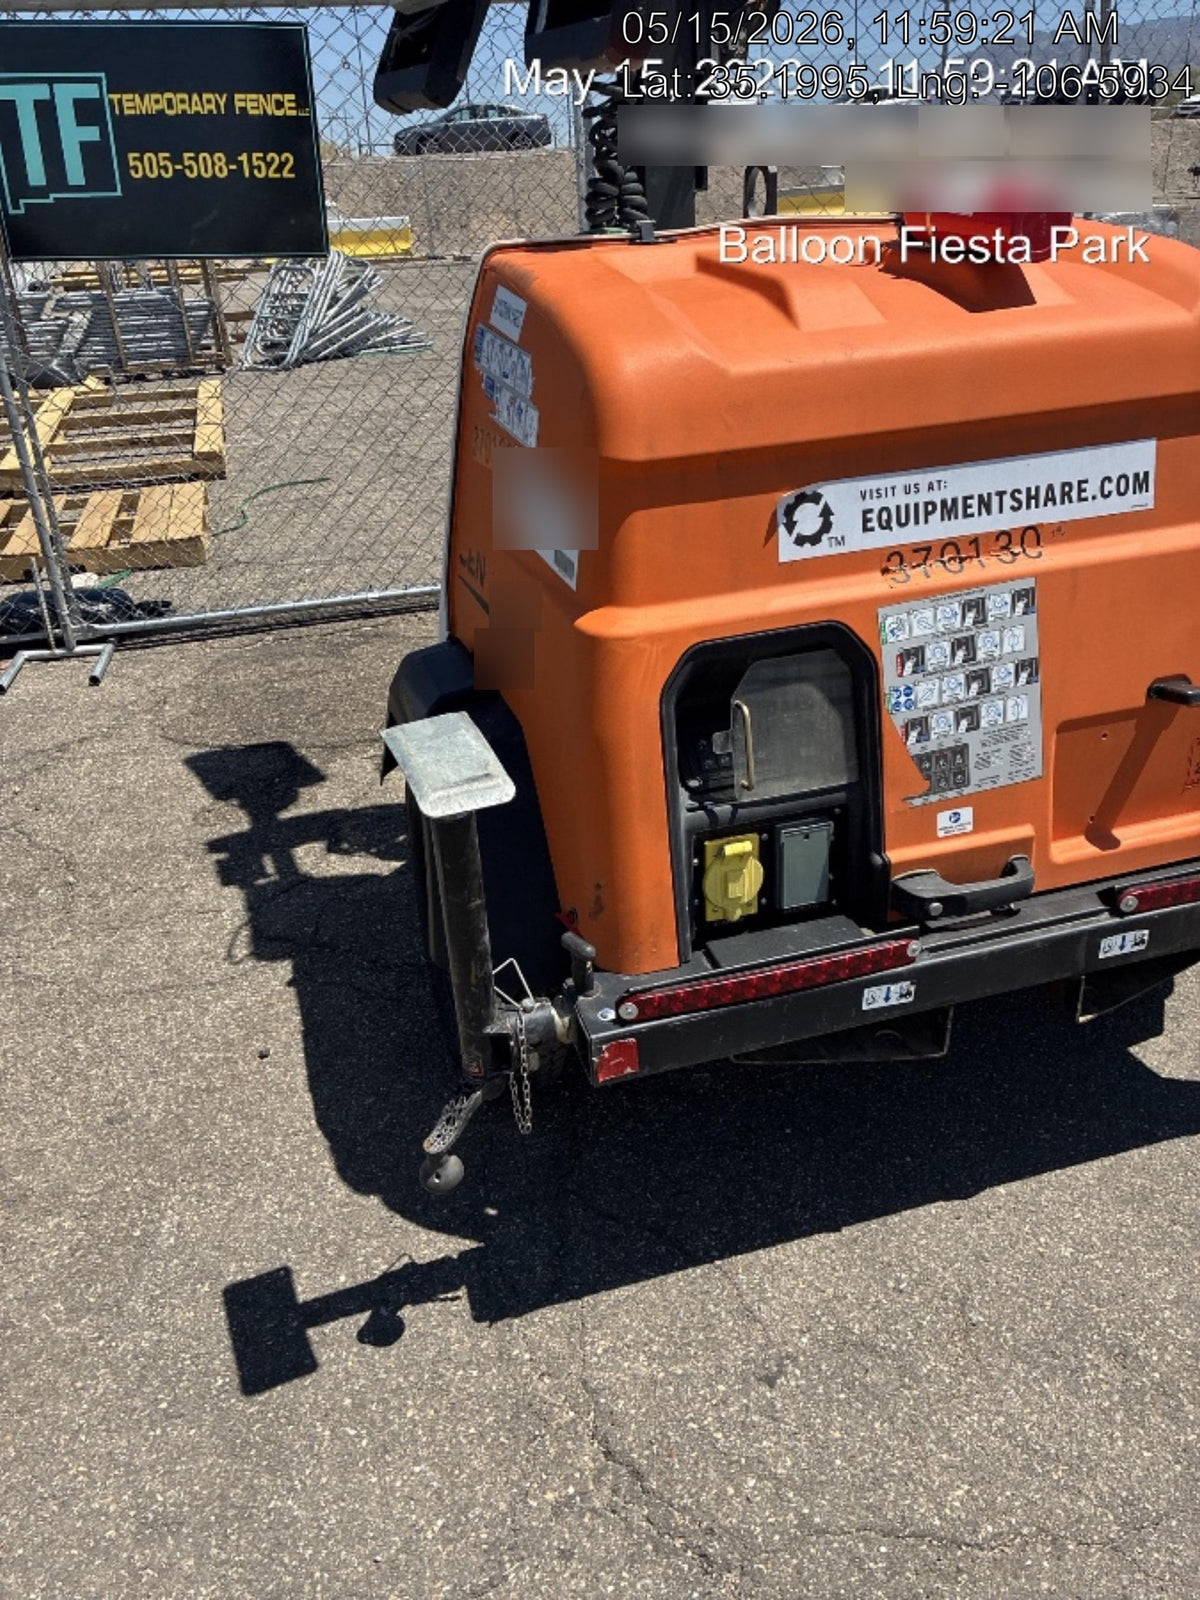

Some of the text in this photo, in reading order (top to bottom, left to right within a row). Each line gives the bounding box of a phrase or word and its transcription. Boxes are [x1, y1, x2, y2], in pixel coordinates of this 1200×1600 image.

[108, 91, 228, 116] TEMPORARY
[234, 93, 297, 116] FENCE
[127, 152, 296, 180] 505-508-1522
[859, 479, 949, 502] VISIT US AT:
[860, 470, 1151, 534] EQUIPMENTSHARE.COM
[827, 535, 847, 549] TM
[882, 525, 1044, 584] 370130
